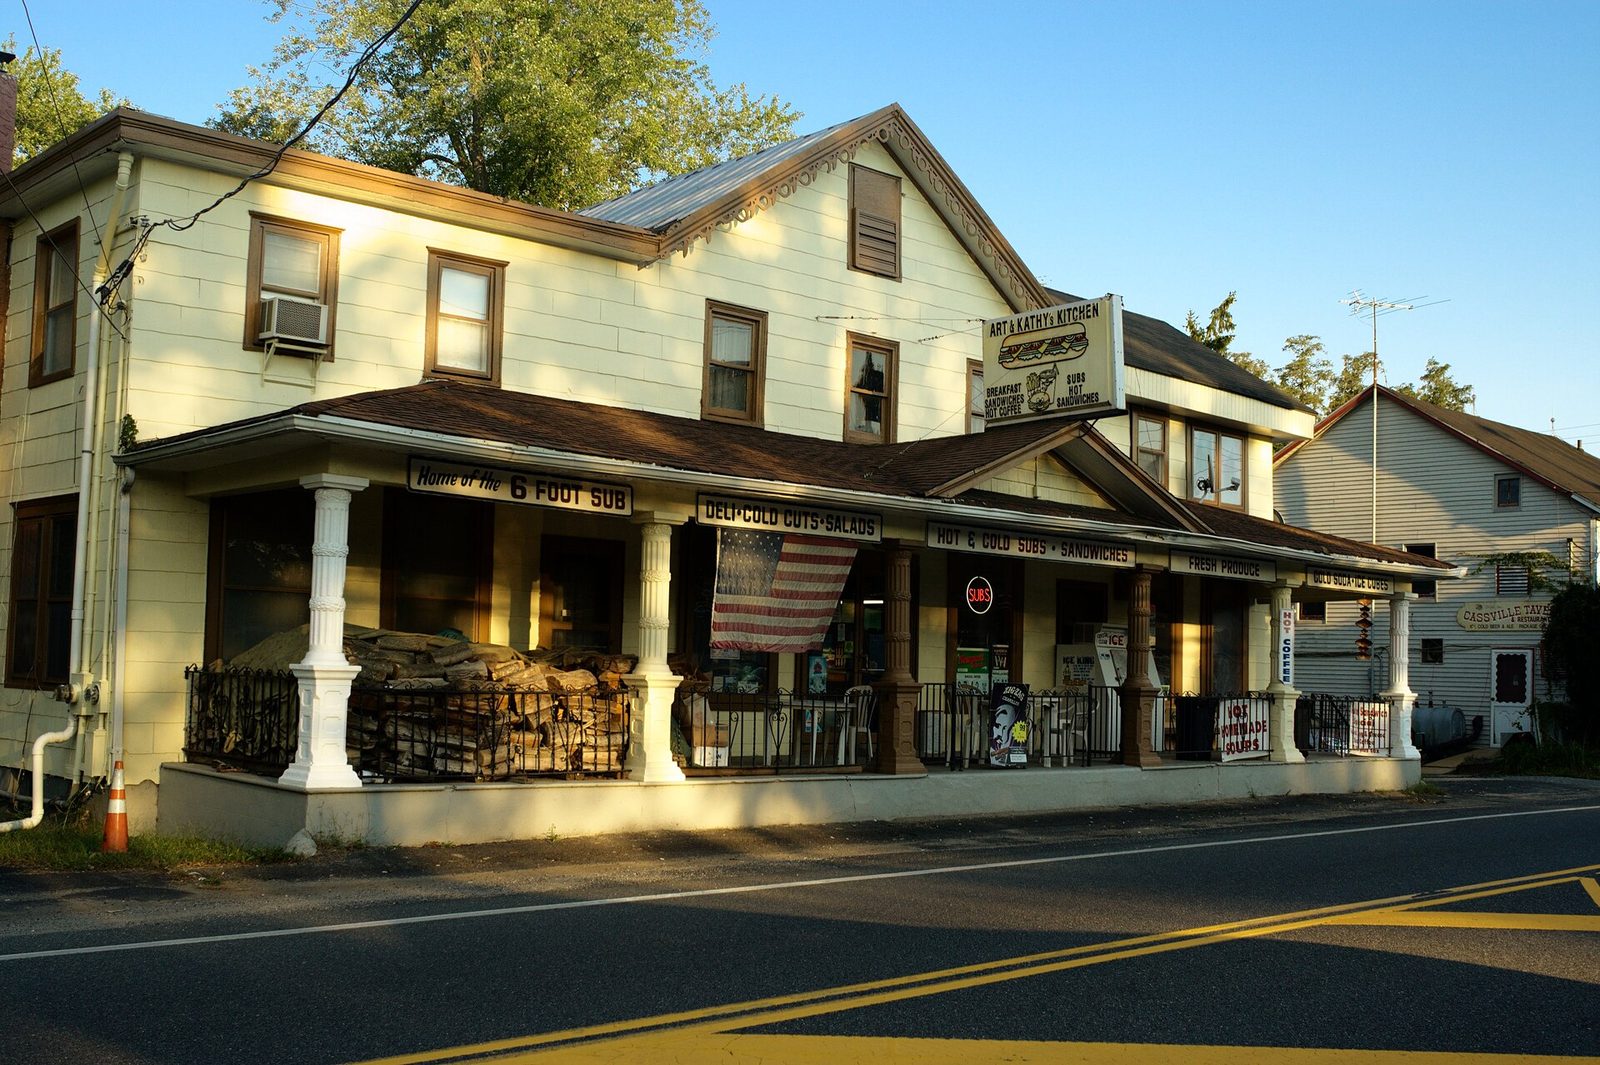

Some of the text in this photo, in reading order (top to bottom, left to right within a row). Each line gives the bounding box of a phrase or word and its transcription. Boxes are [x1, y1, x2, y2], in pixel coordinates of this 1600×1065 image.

[990, 320, 1007, 338] ART
[1009, 321, 1015, 333] &
[1057, 302, 1100, 325] KITCHEN
[1066, 372, 1086, 385] SUBS
[986, 383, 1022, 398] BREAKFAST
[1068, 384, 1083, 396] HOT
[984, 394, 1025, 409] SANDWICHES
[1056, 392, 1099, 408] SANDWICHES
[985, 404, 1022, 418] HOT COFFEE
[417, 465, 626, 511] Home of the 6 FOOT SUB
[705, 500, 875, 536] DELI COLD CUTS SALADS
[937, 527, 1129, 563] HOT & COLD SUBS SANDWICHES
[1188, 555, 1260, 577] FRESH PRODUCE
[1313, 570, 1389, 591] COLD SODA ICE CUBES
[968, 588, 991, 602] SUBS
[1283, 611, 1292, 634] HOT
[1463, 605, 1551, 623] CASSVILLE TAVE
[1108, 634, 1125, 646] ICE
[1063, 655, 1075, 665] ICE
[1283, 638, 1291, 683] COFFEE
[1225, 738, 1260, 756] SOUPS
